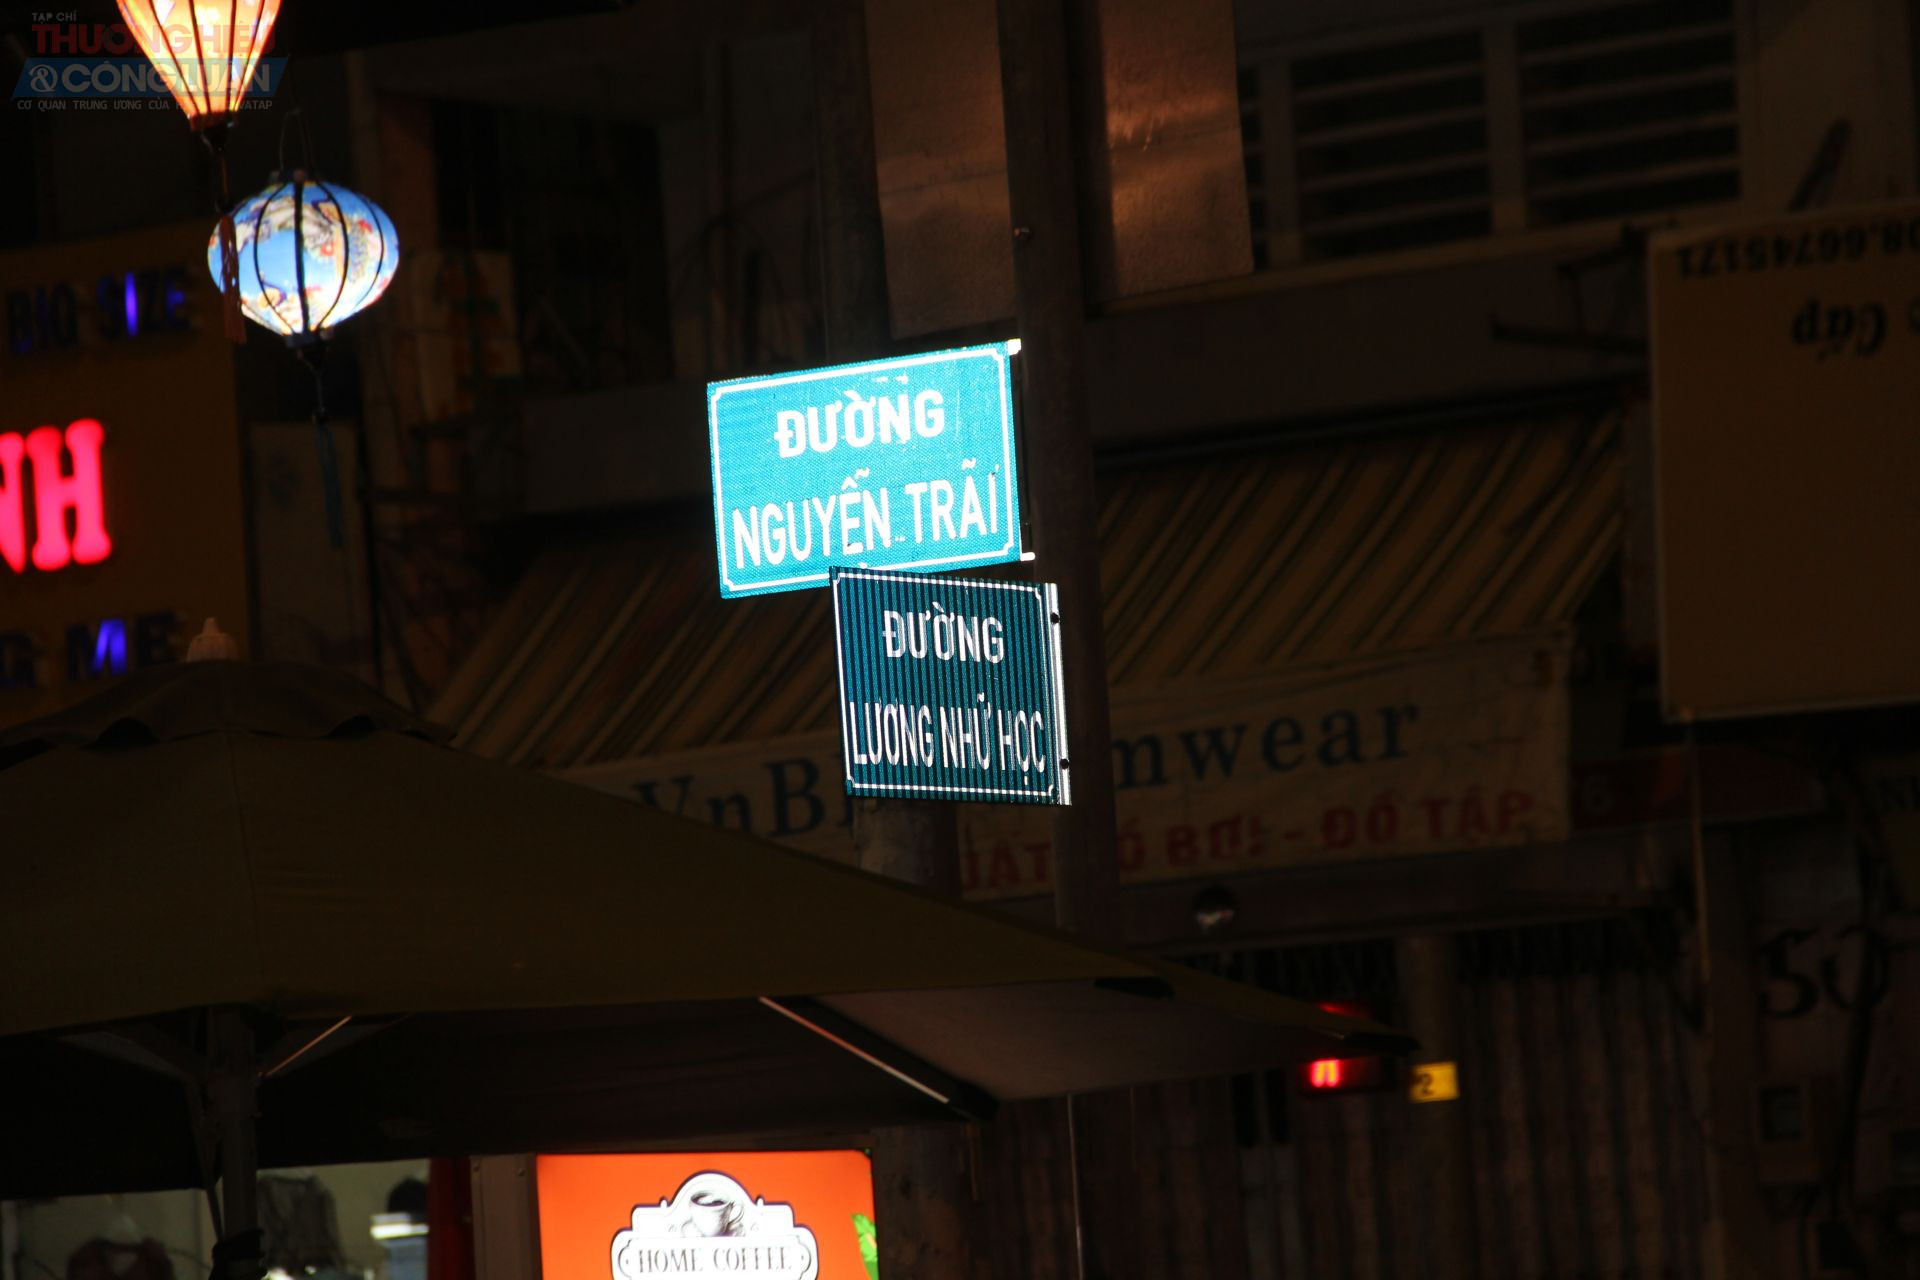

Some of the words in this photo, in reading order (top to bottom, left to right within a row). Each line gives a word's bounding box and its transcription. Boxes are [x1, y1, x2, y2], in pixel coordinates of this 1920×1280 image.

[97, 267, 192, 341] SIZE
[774, 389, 945, 459] ĐƯỜNG
[732, 467, 892, 569] NGUYỄN
[905, 458, 1000, 544] TRÃI
[882, 601, 1004, 663] ĐƯỜNG
[849, 697, 934, 768] LƯƠNG
[998, 709, 1046, 786] HỌC
[638, 1247, 703, 1273] HOME
